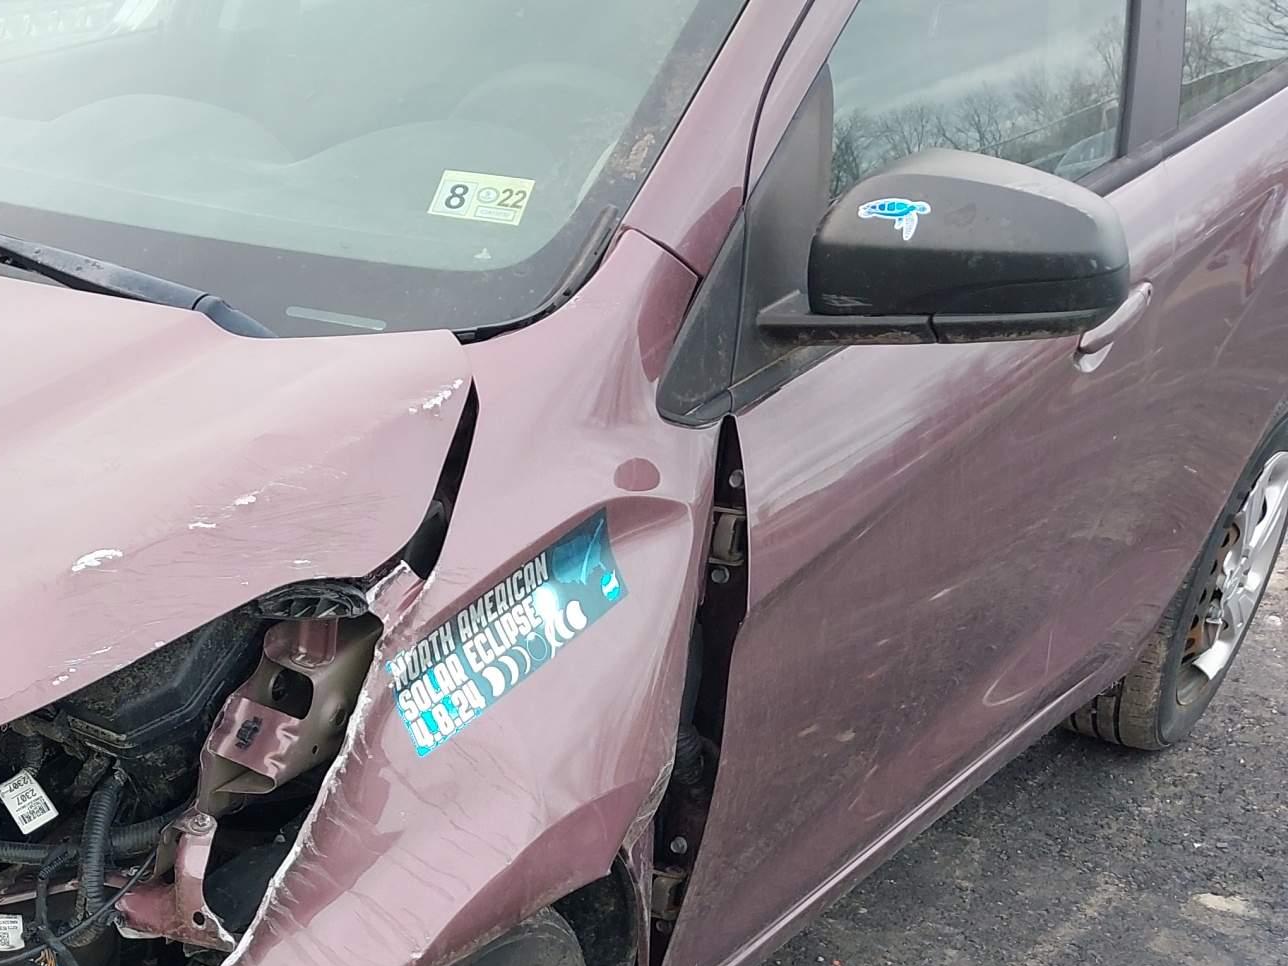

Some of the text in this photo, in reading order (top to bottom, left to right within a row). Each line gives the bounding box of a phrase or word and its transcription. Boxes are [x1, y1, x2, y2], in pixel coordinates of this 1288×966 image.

[444, 184, 527, 209] 8 22
[390, 552, 549, 690] NORTH AMERICAN
[398, 596, 543, 721] SOLAR ECLIPSE
[8, 776, 29, 793] 2307
[16, 788, 37, 806] 2307
